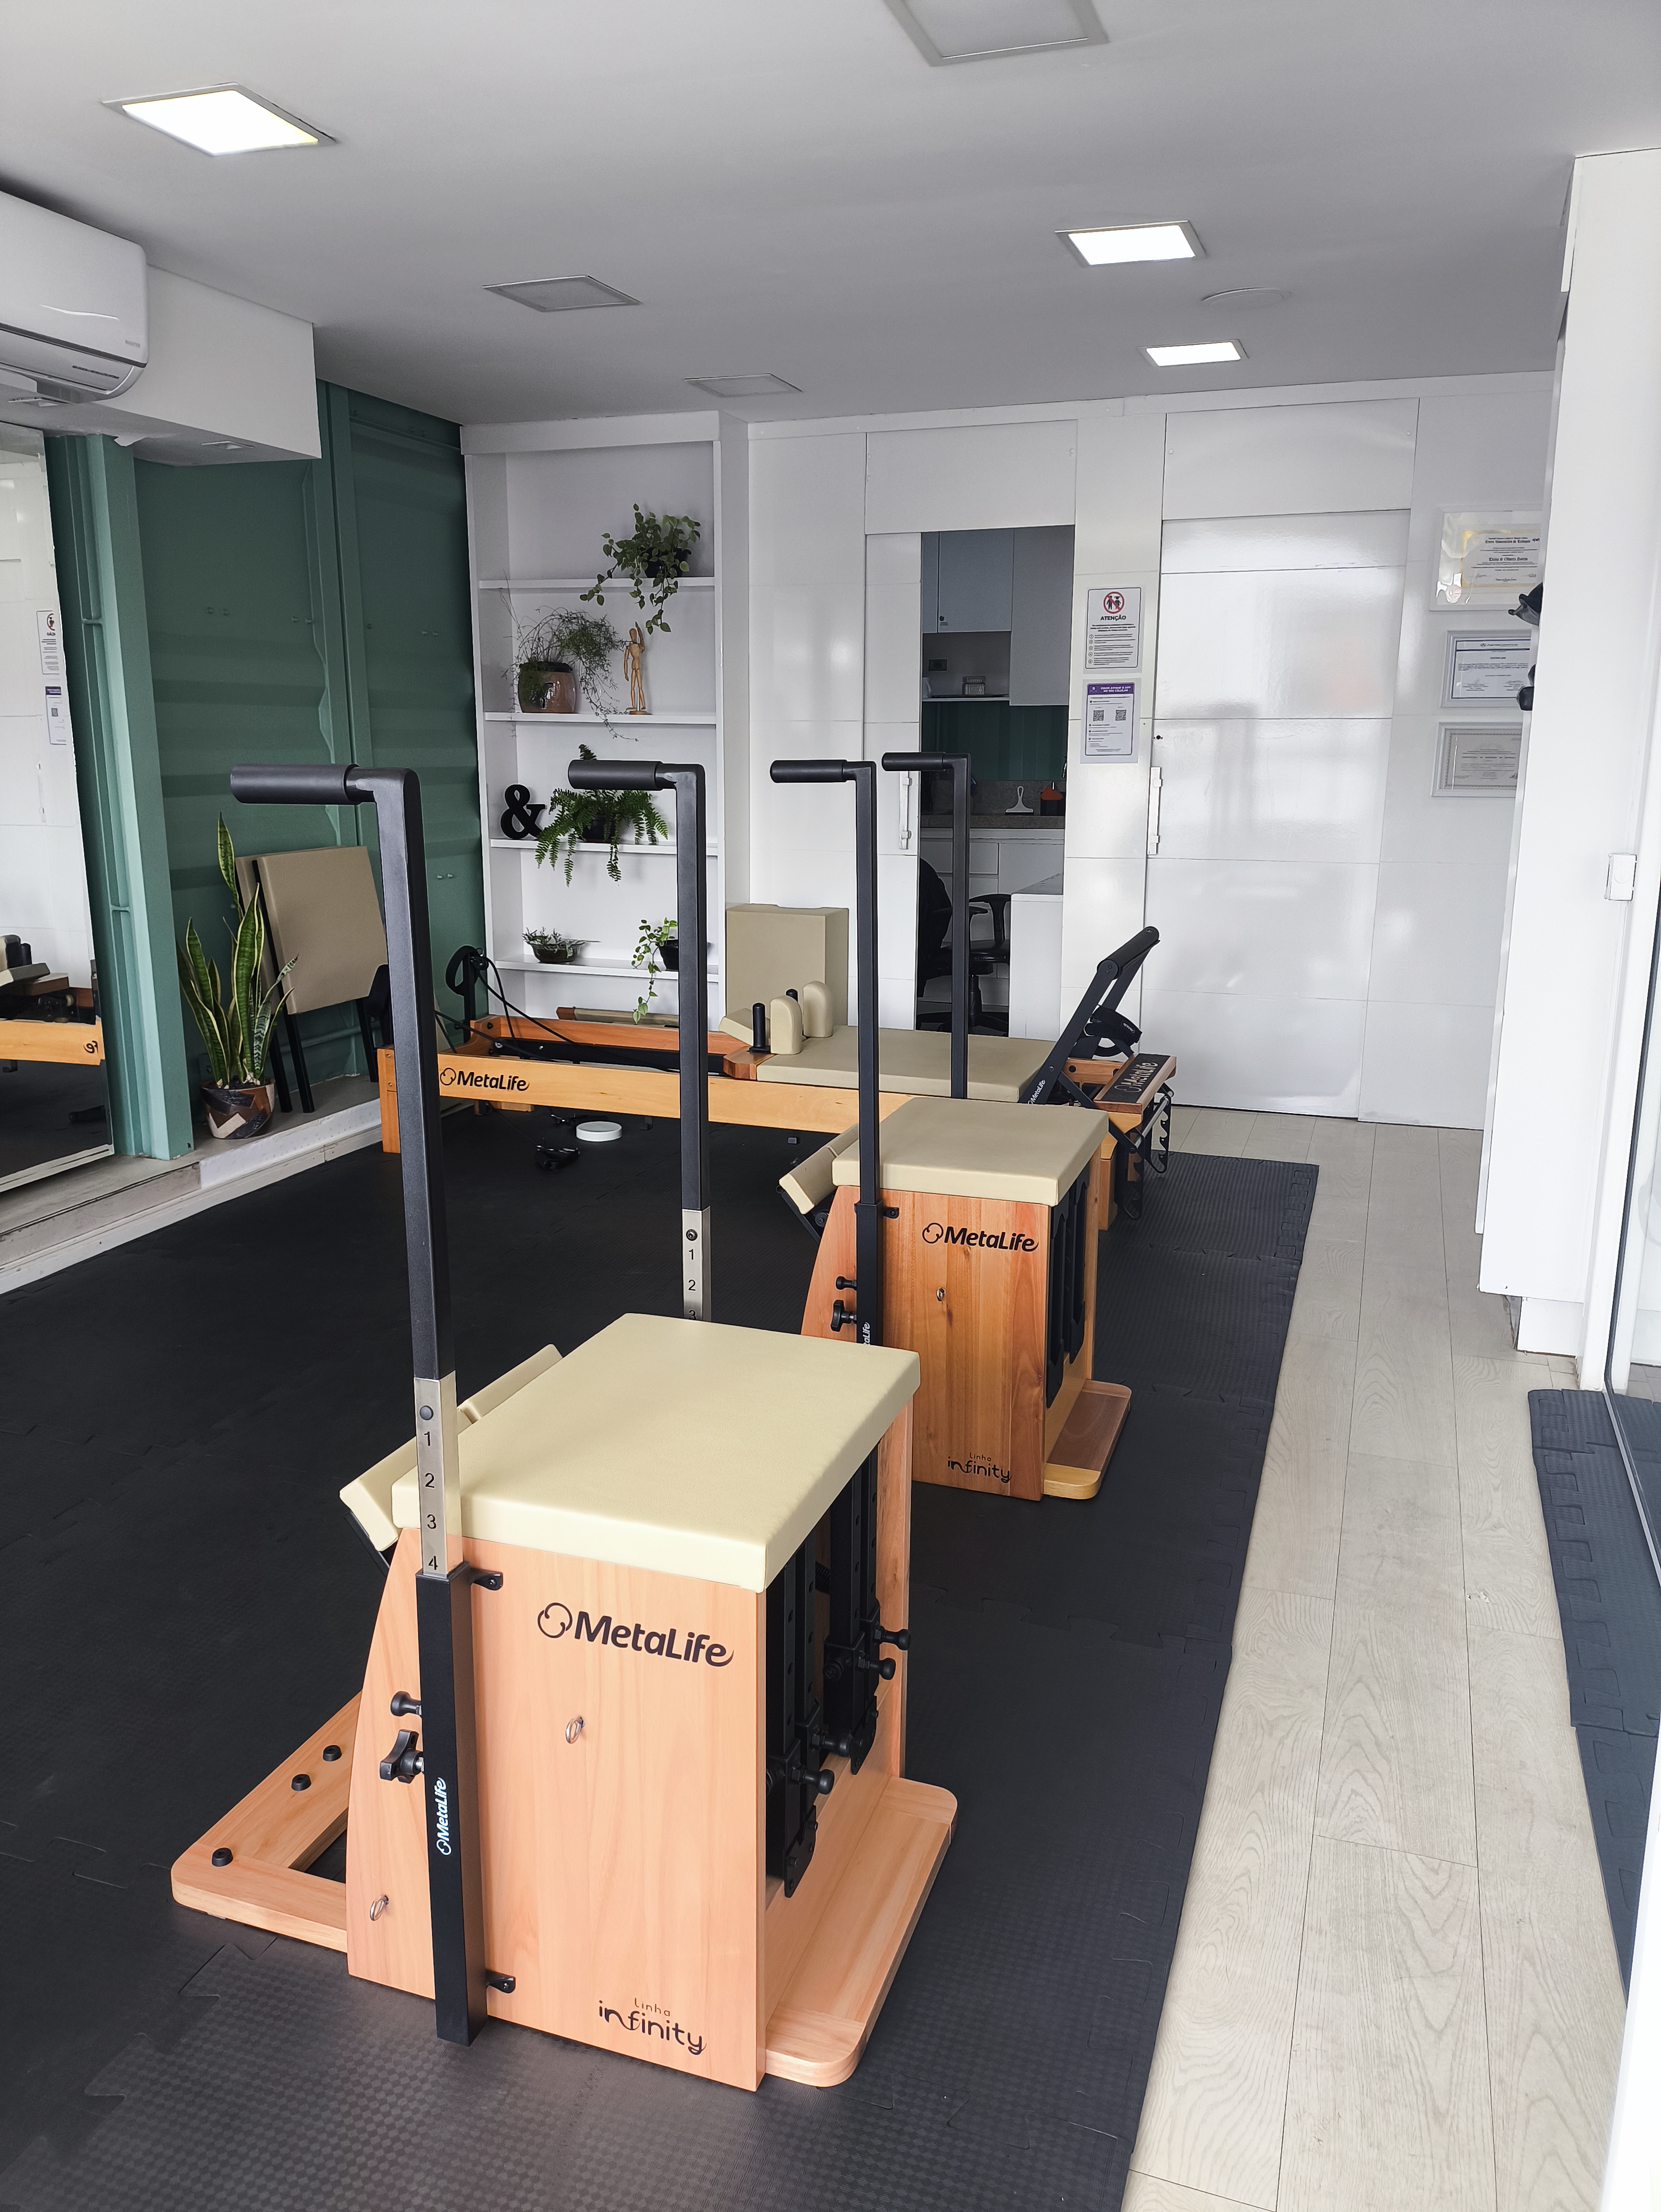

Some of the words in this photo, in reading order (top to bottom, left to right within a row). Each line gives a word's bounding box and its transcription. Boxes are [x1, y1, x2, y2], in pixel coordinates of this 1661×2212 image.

[457, 1070, 530, 1091] MetaLife
[1120, 1062, 1158, 1087] MetaLife
[1030, 1079, 1046, 1103] MetaLife
[944, 1226, 1039, 1252] MetaLife
[688, 1249, 694, 1260] 1
[688, 1279, 696, 1291] 2
[689, 1310, 696, 1320] 3
[862, 1322, 870, 1345] aLife
[424, 1431, 431, 1447] 1
[948, 1456, 1012, 1483] infinity
[425, 1473, 435, 1489] 2
[427, 1514, 437, 1529] 3
[428, 1555, 438, 1571] 4
[574, 1611, 734, 1667] MetaLife
[434, 1777, 450, 1842] MetaLife
[599, 2000, 707, 2056] infinity
